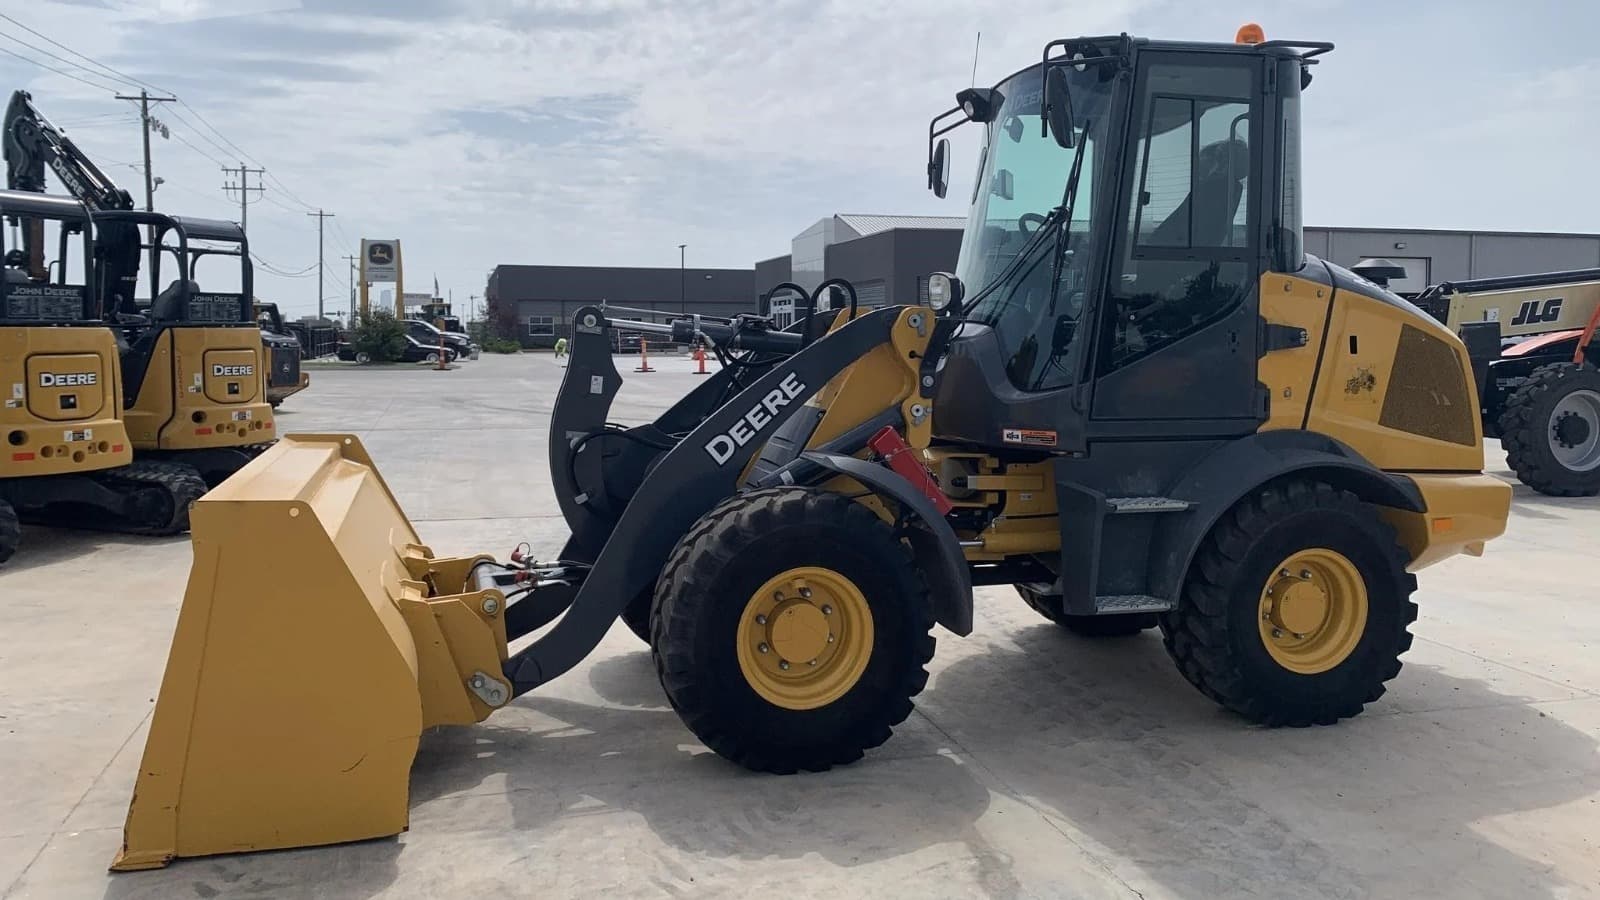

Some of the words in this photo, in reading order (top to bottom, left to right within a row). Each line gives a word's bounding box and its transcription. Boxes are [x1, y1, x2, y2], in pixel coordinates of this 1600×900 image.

[52, 157, 85, 198] DEERE
[12, 286, 42, 295] JOHN
[44, 287, 79, 297] DEERE
[1511, 298, 1564, 326] JLG
[40, 373, 97, 387] DEERE
[213, 364, 254, 377] DEERE
[704, 371, 806, 466] DEERE
